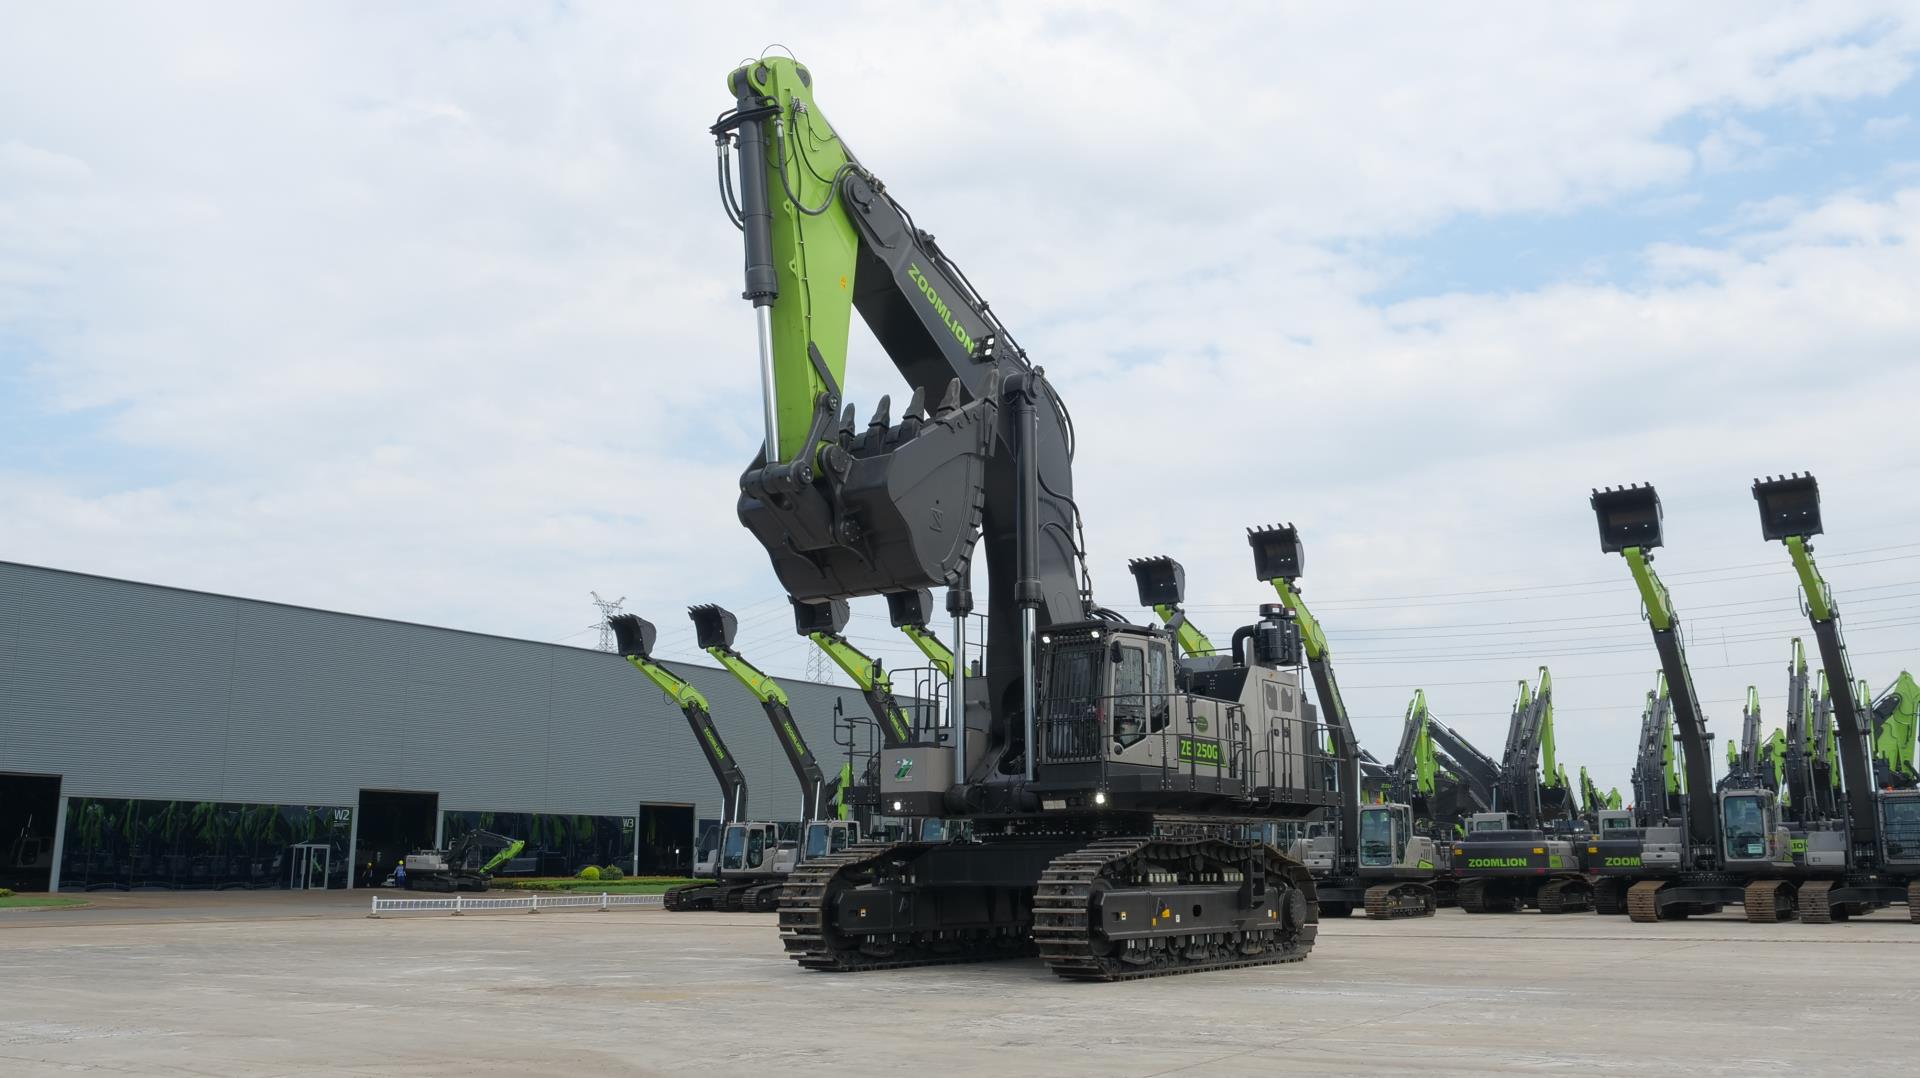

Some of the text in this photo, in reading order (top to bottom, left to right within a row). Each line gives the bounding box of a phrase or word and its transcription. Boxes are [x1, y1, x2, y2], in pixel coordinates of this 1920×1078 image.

[907, 262, 976, 354] ZOOMLION
[334, 809, 350, 820] W2
[622, 818, 634, 828] W3
[1468, 858, 1527, 867] ZOOMLION
